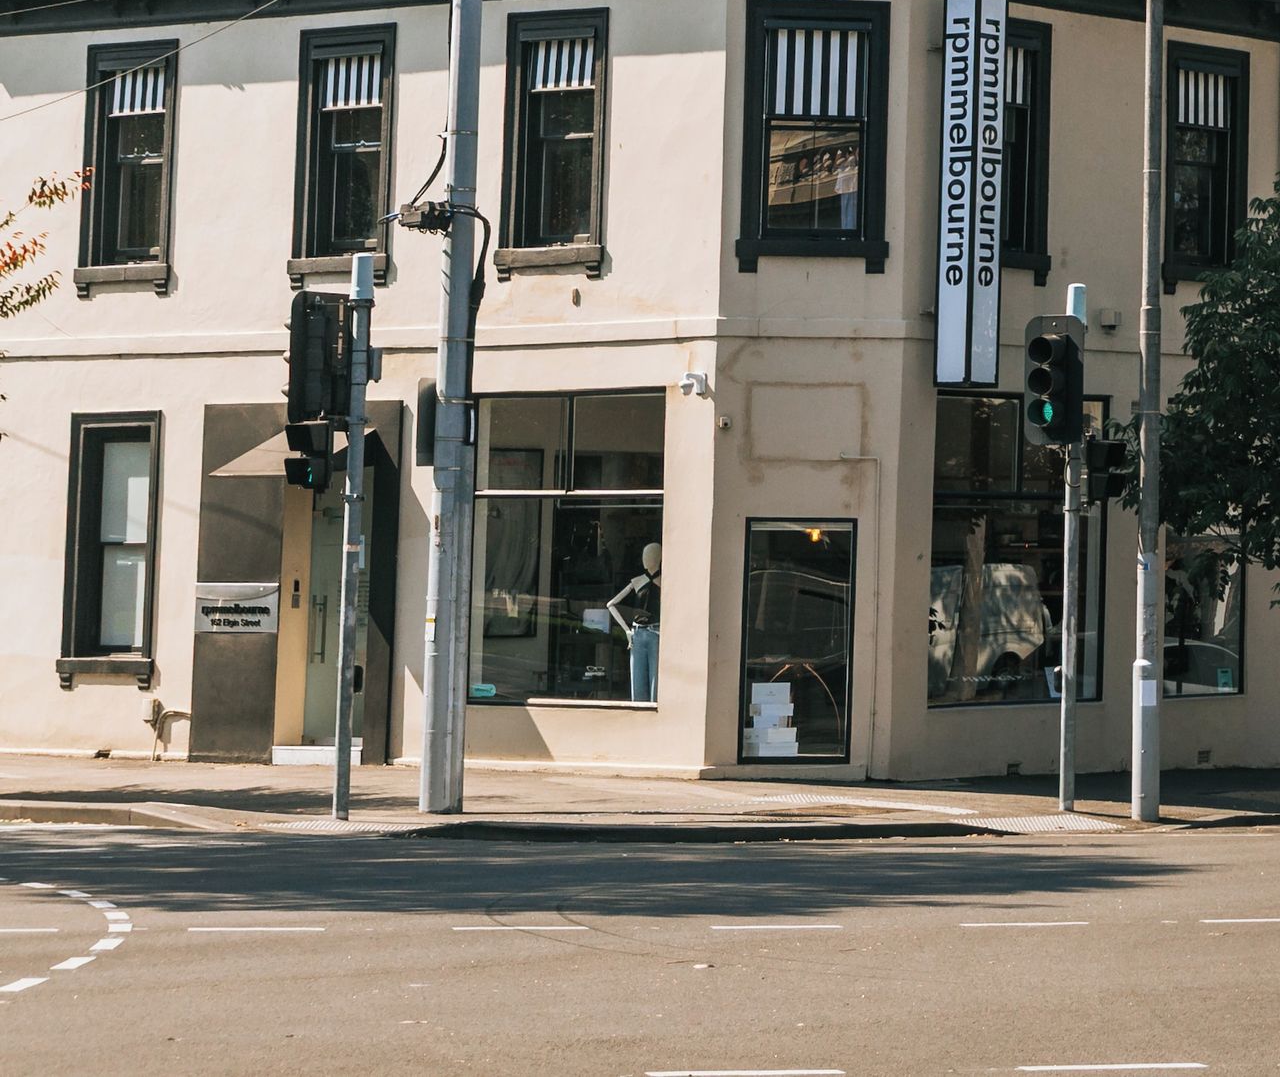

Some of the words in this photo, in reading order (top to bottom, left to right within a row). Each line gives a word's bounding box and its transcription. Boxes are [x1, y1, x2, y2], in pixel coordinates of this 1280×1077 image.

[946, 17, 973, 286] rpmmelbourne
[978, 18, 1002, 287] rpmmelbourne
[223, 618, 240, 628] Elgin
